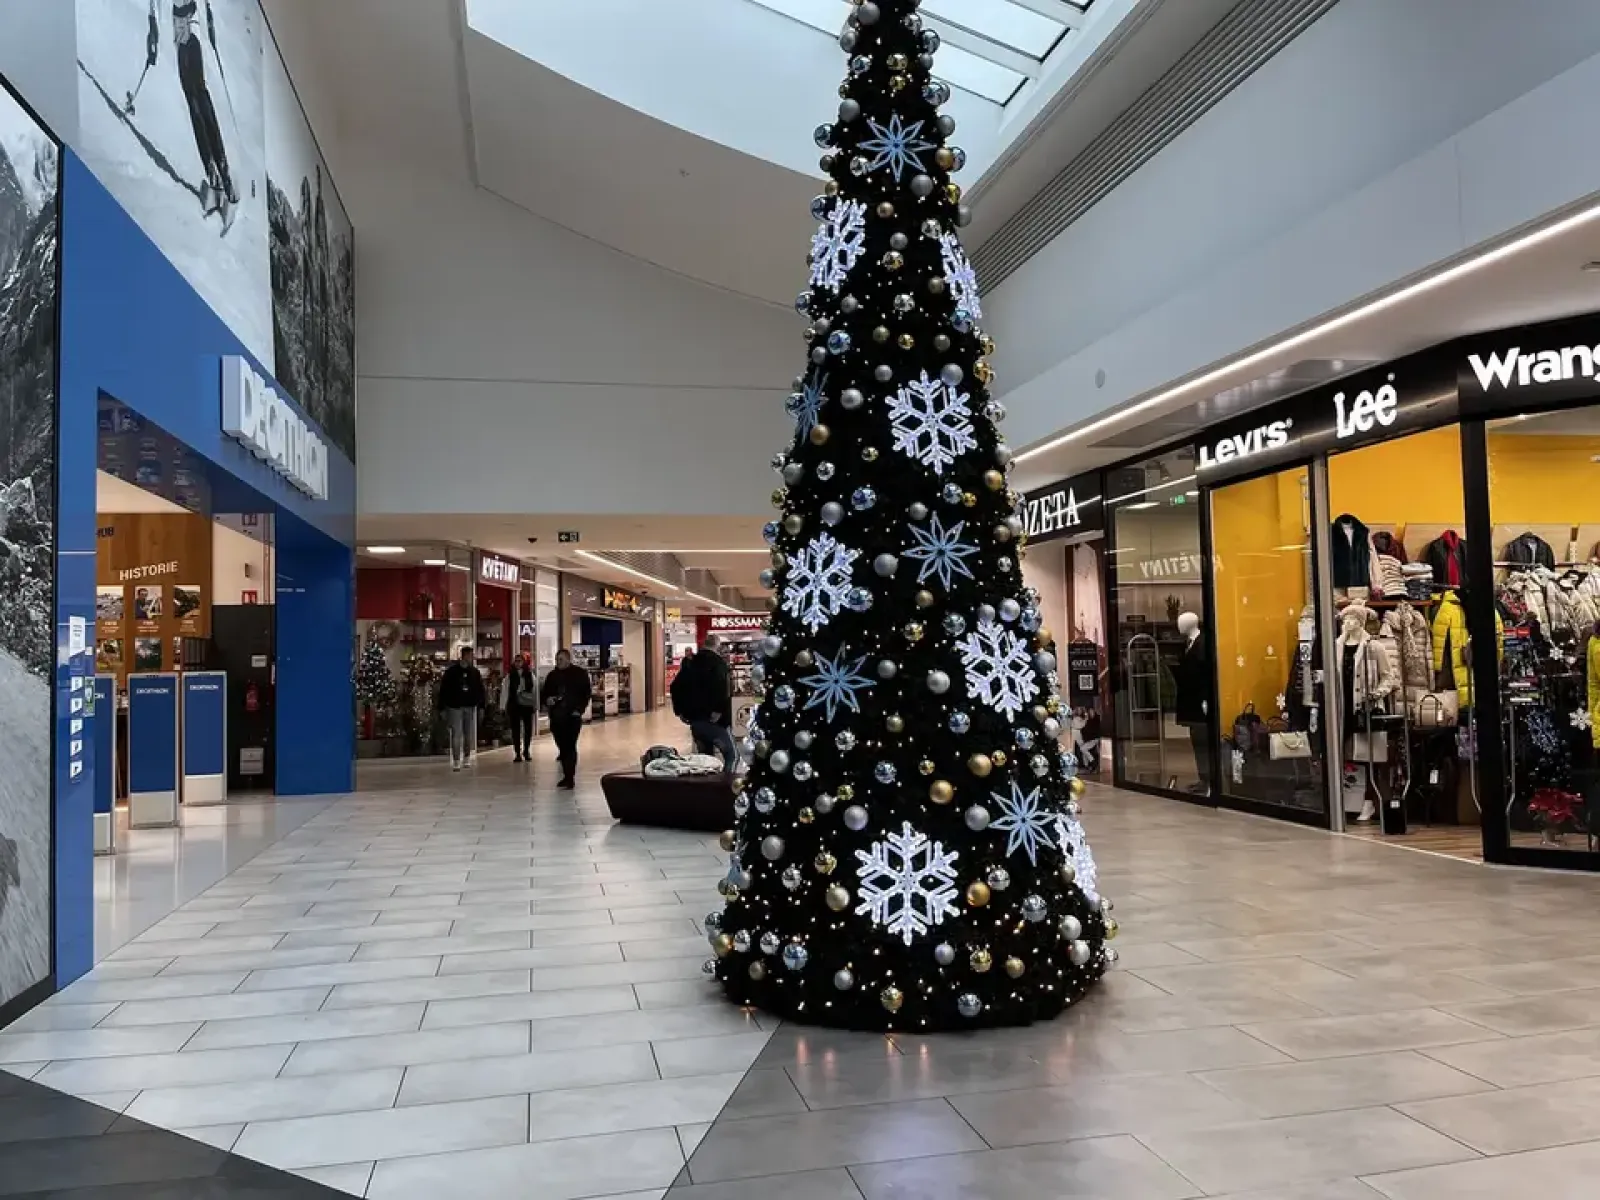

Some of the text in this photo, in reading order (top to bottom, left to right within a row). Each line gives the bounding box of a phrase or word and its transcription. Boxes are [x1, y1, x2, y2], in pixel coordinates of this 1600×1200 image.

[1467, 343, 1600, 393] Wran
[232, 355, 328, 500] DECATHLON
[1333, 384, 1397, 438] Lee
[120, 561, 179, 581] HISTORIE
